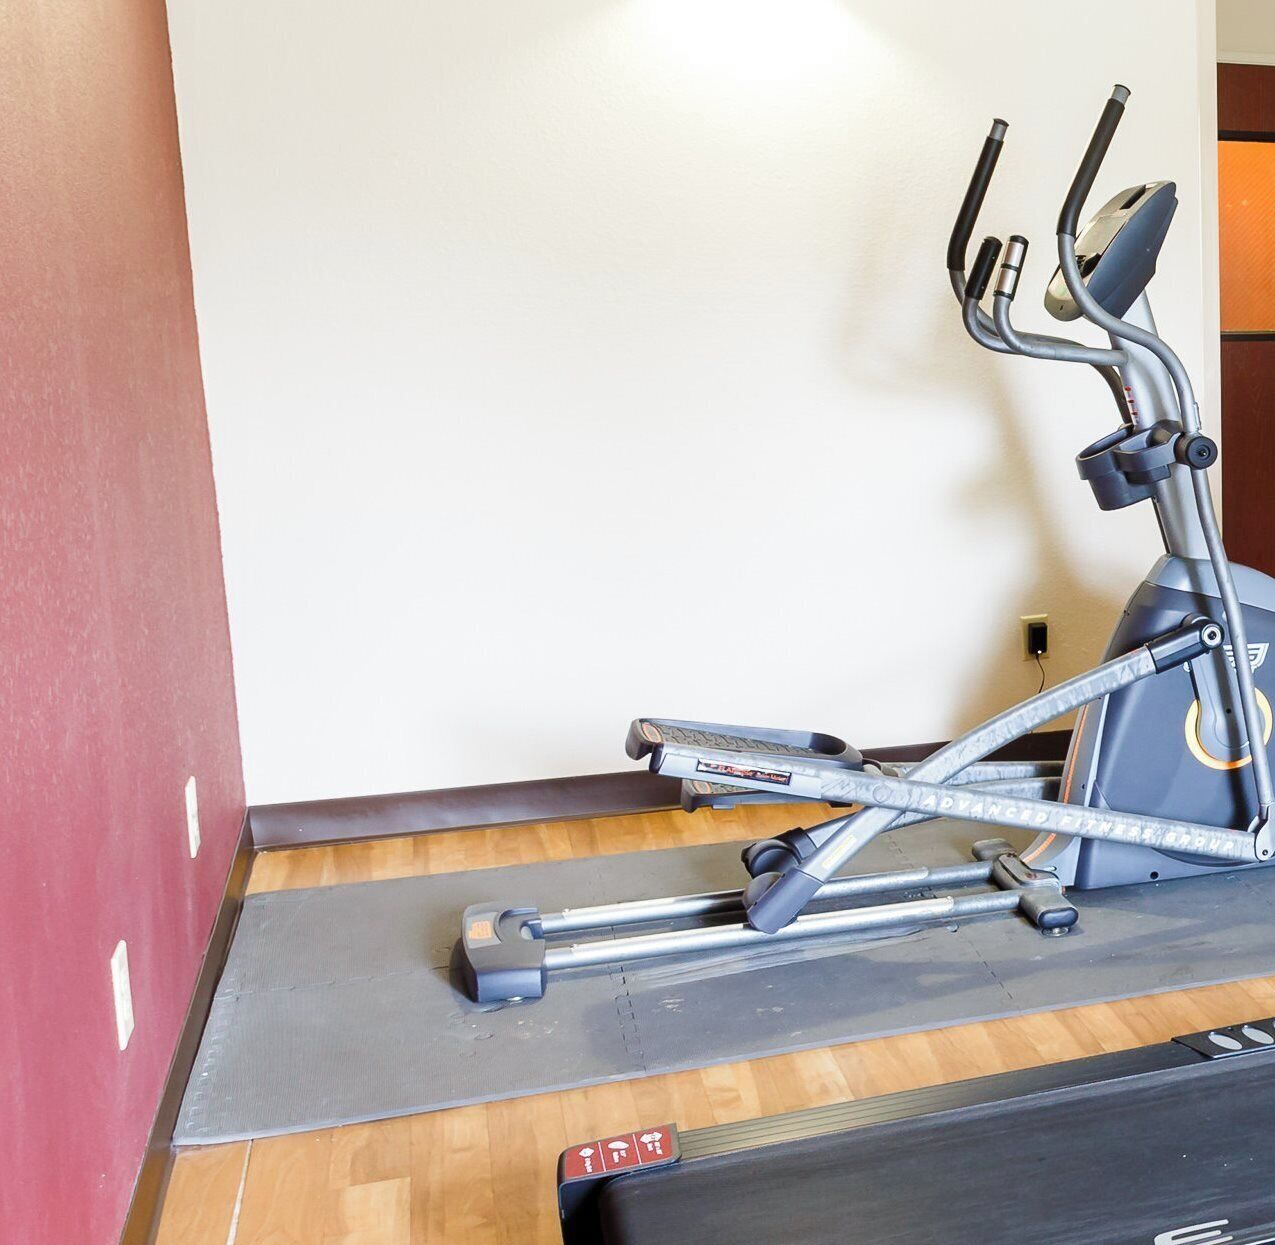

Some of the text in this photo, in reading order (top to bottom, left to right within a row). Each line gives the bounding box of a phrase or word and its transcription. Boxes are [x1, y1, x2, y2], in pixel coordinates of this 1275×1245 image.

[922, 794, 1236, 853] ADVANCED FITNESS GROUP
